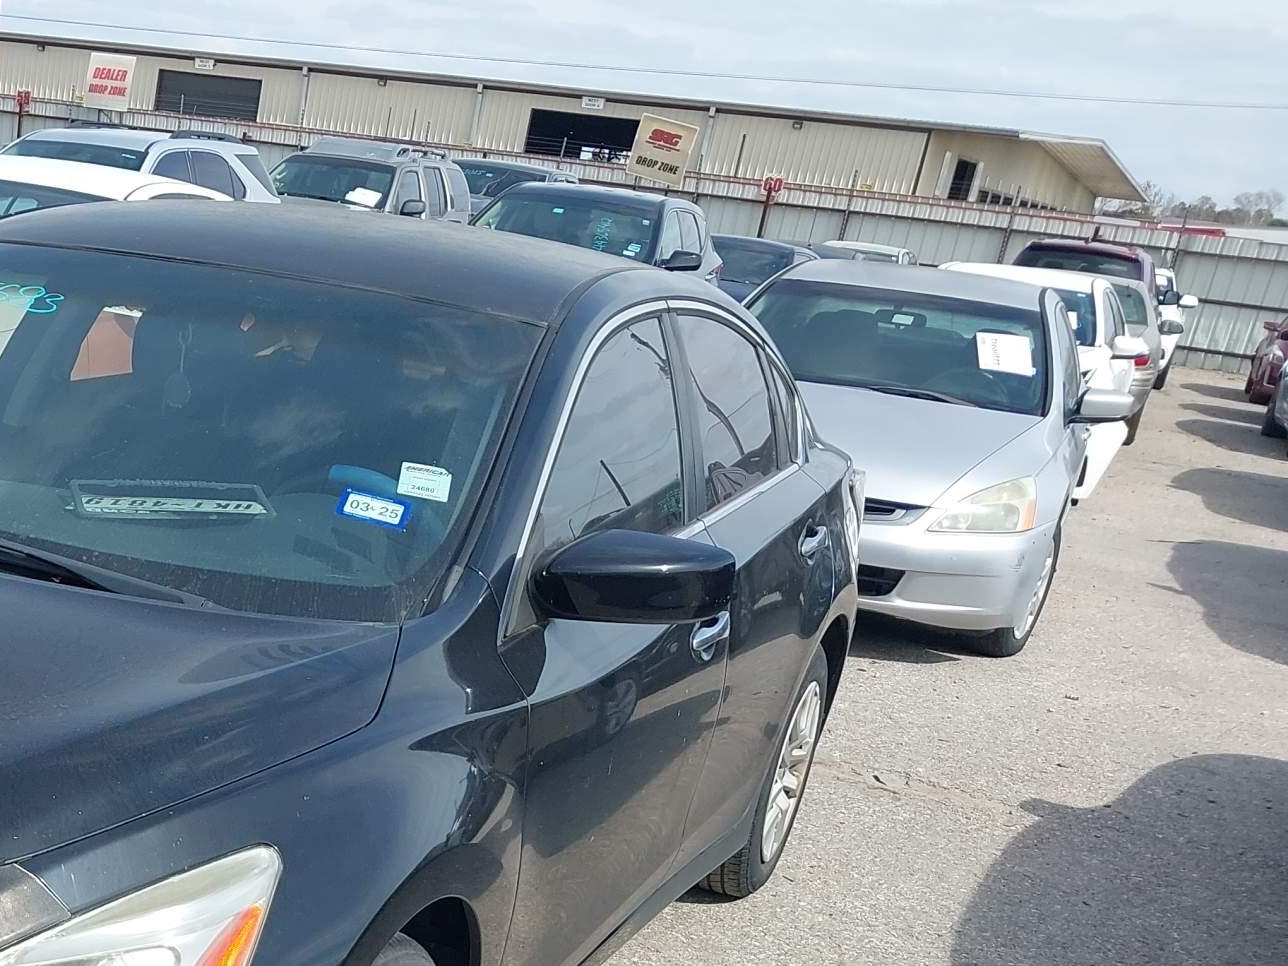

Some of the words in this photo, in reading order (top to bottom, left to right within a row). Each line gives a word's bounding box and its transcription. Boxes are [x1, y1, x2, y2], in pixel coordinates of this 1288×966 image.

[92, 67, 128, 82] DEALER
[88, 83, 108, 95] DROP
[108, 85, 128, 97] ZONE
[635, 155, 659, 168] DROP
[657, 162, 680, 175] ZONE
[763, 176, 782, 192] 60
